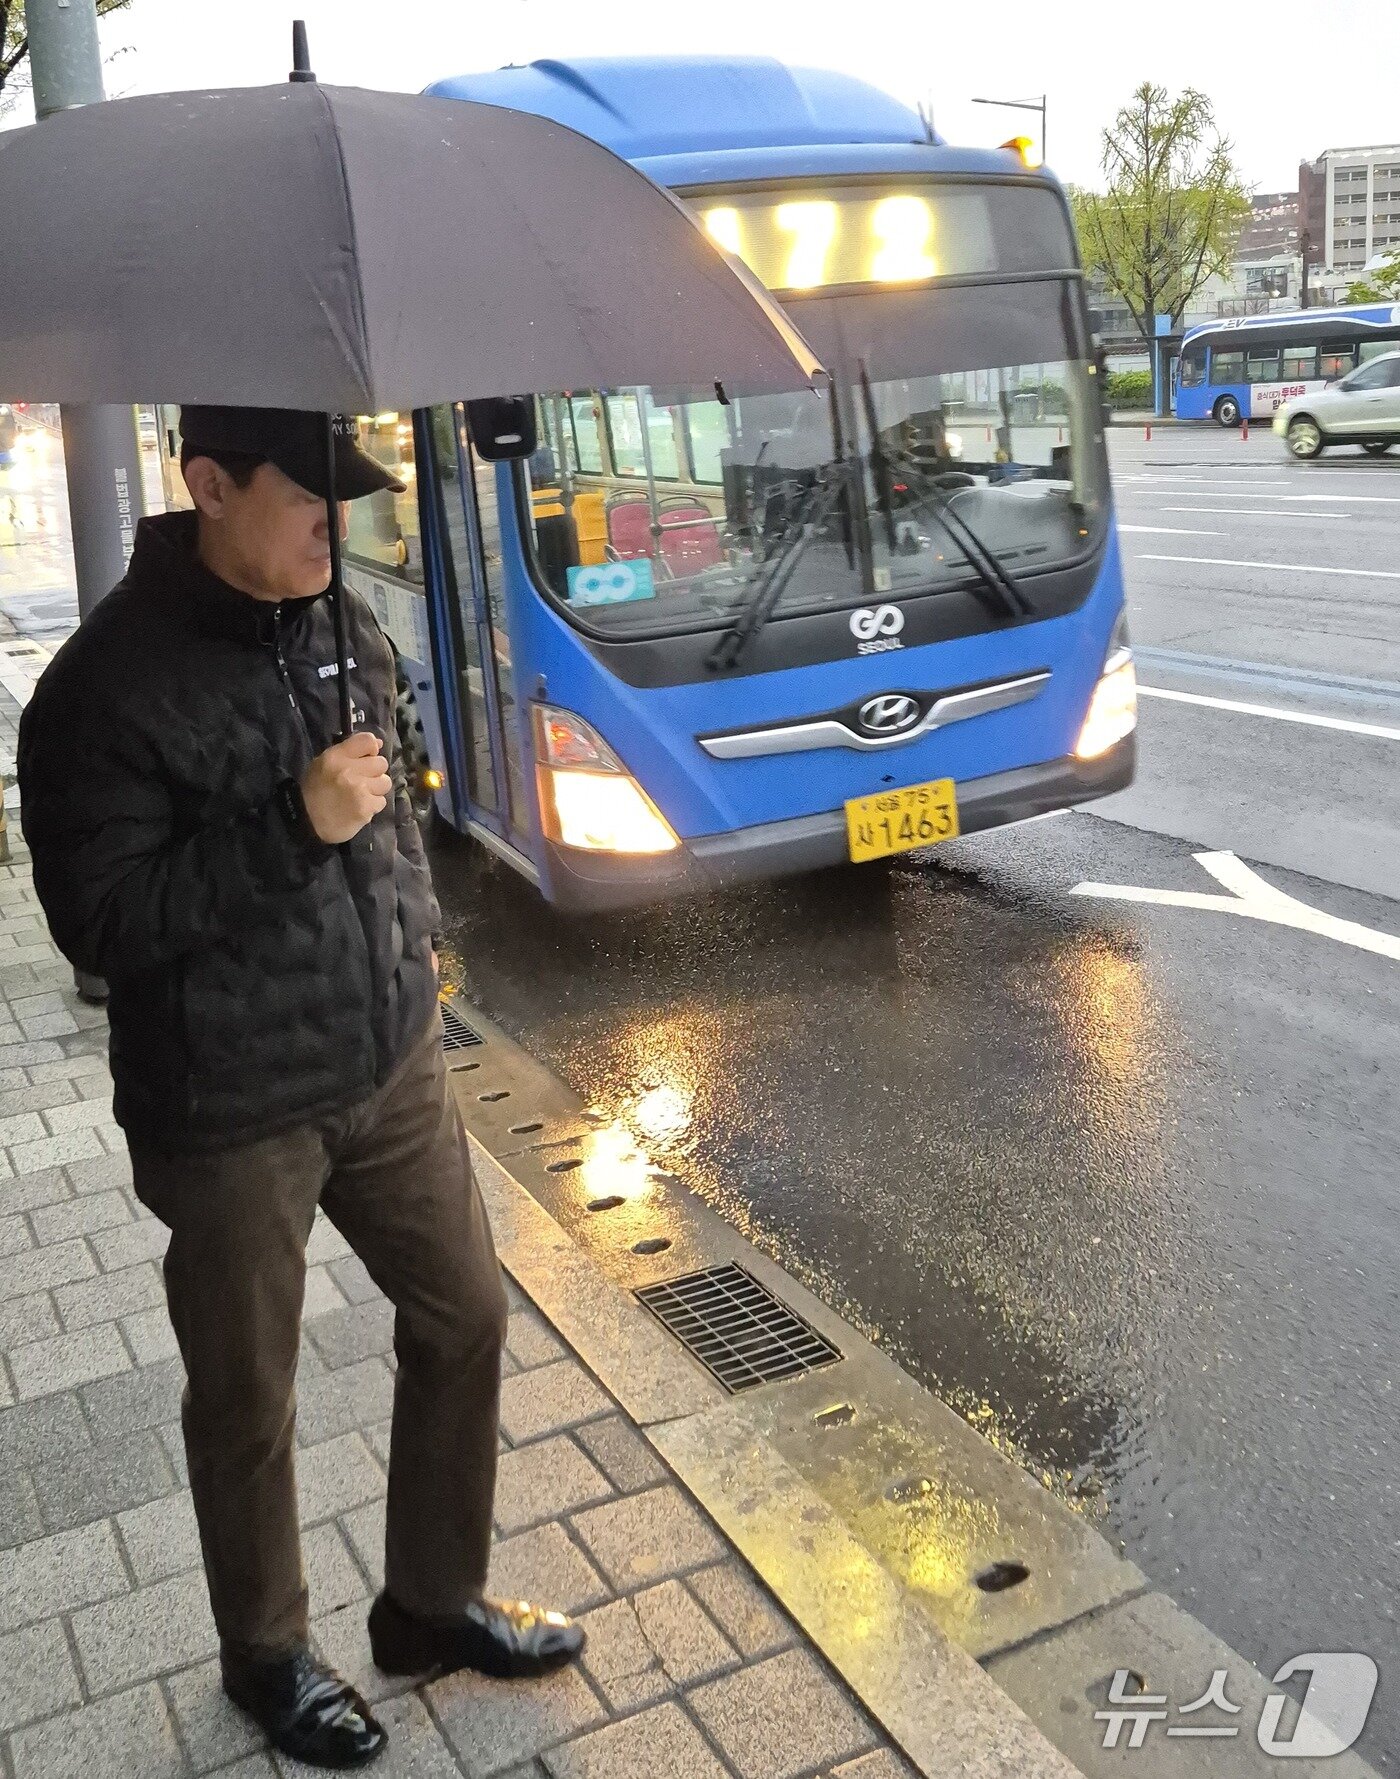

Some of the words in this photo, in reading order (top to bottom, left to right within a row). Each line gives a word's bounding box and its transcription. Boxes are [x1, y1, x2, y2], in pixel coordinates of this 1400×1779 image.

[1225, 318, 1245, 328] EV
[849, 604, 905, 640] GO
[856, 636, 905, 655] SEOUL
